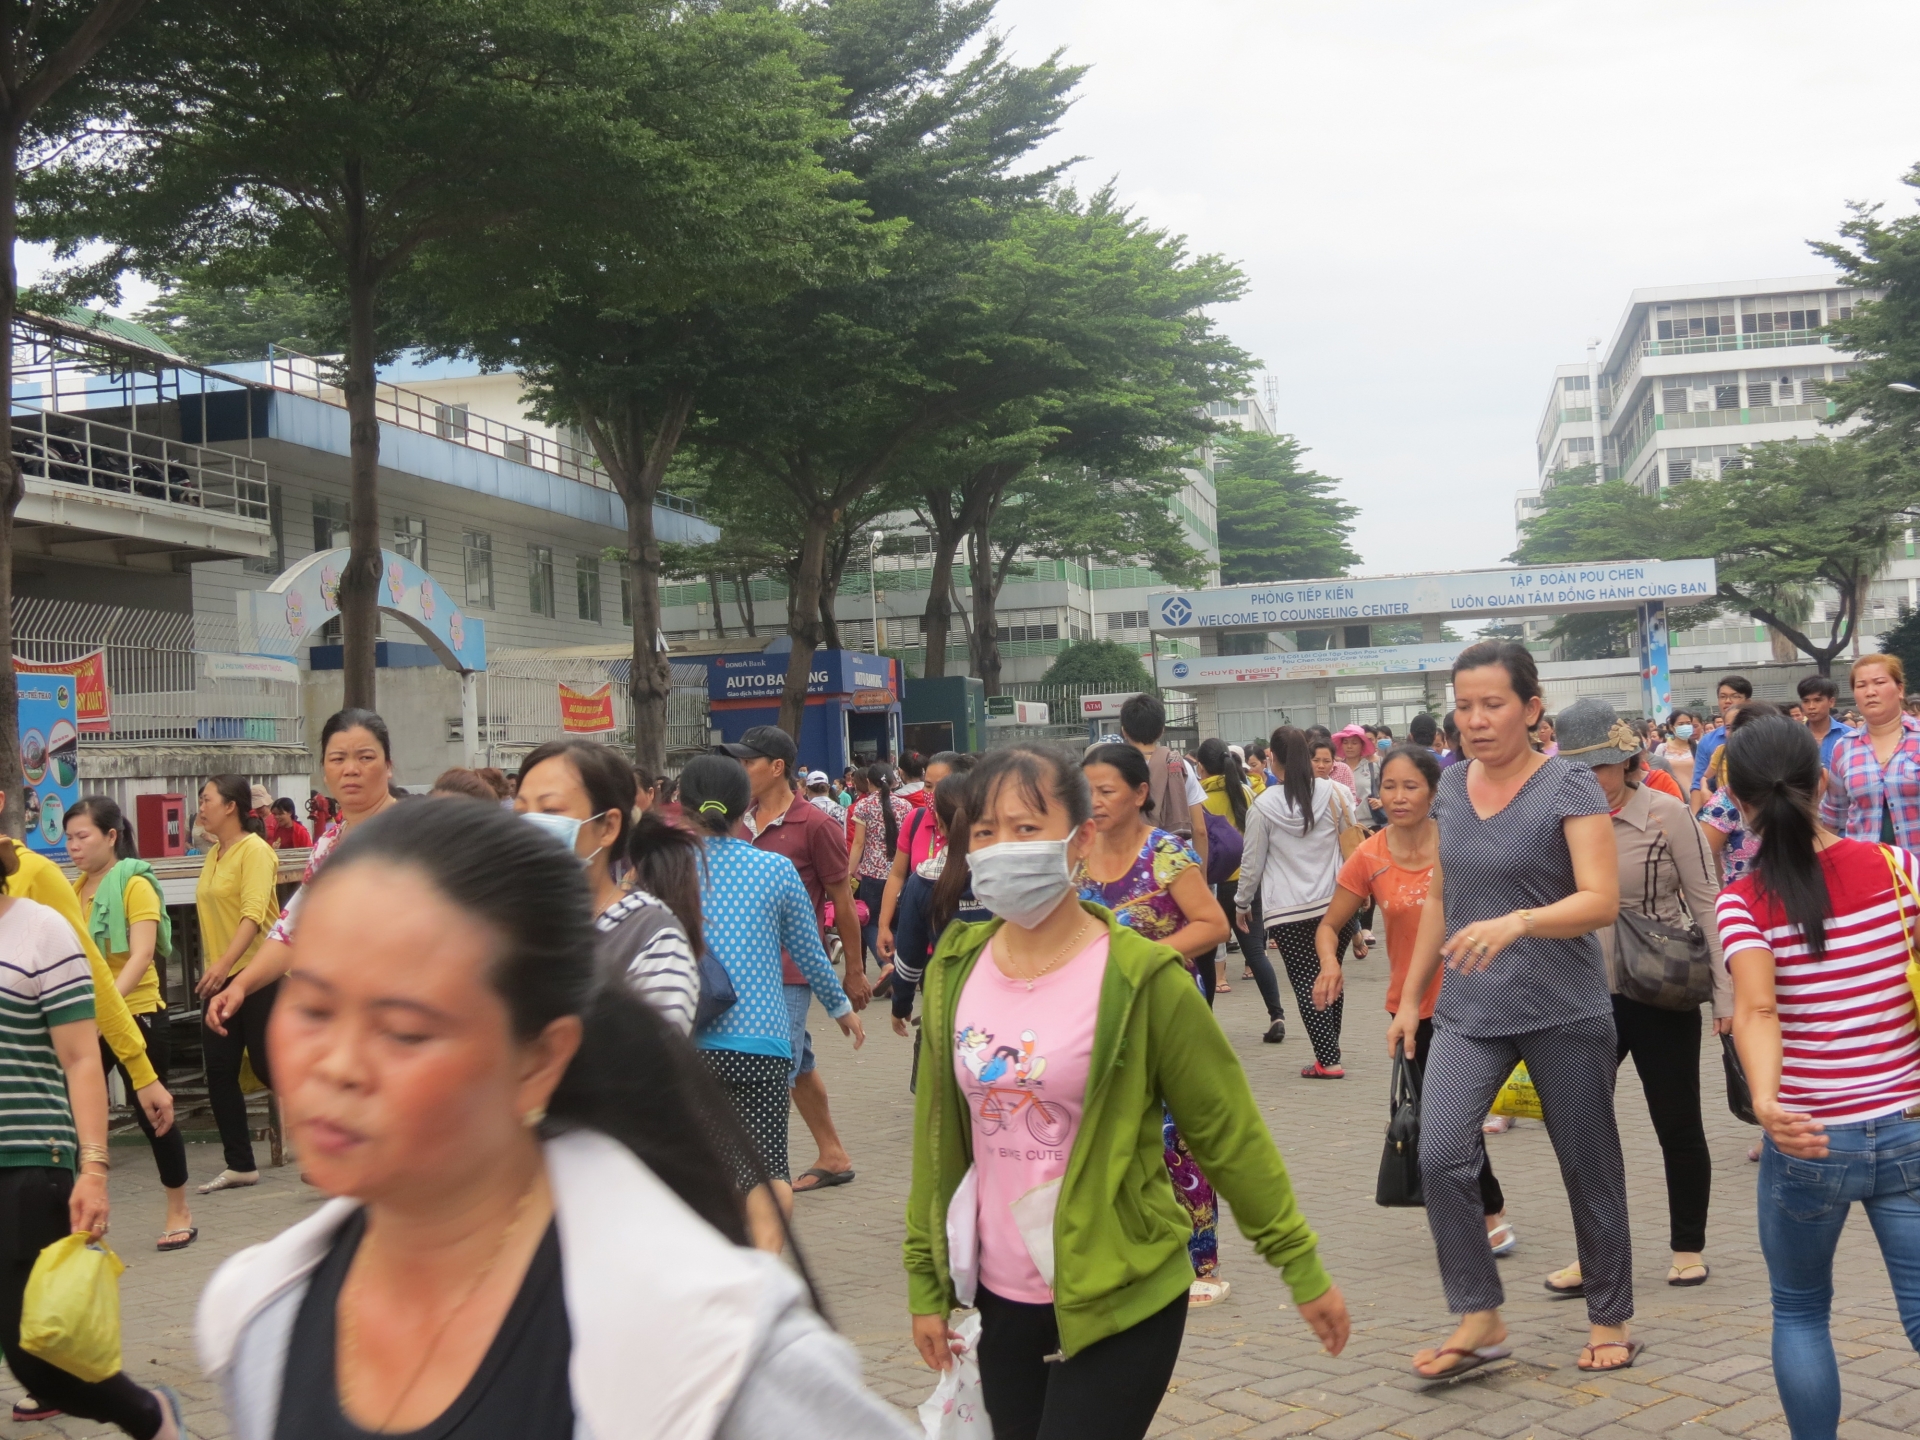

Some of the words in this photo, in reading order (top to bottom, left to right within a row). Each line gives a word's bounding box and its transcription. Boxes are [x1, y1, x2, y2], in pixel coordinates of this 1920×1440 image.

[1510, 574, 1532, 588] TẬP
[1540, 570, 1576, 586] ĐOÀN
[1580, 570, 1605, 583] POU
[1609, 568, 1644, 581] CHEN
[1251, 590, 1294, 605] PHÒNG
[1297, 586, 1322, 602] TIẾP
[1325, 584, 1354, 600] KIẾN
[1451, 595, 1484, 609] LUÔN
[1487, 593, 1525, 607] QUAN
[1528, 590, 1554, 604] TÂM
[1558, 586, 1596, 603] ĐỒNG
[1599, 586, 1635, 600] HÀNH
[1638, 583, 1677, 597] CÙNG
[1680, 582, 1707, 596] BẠN
[1198, 611, 1259, 627] WELCOME
[1262, 611, 1277, 623] TO
[1280, 605, 1359, 622] COUNSELING
[1362, 602, 1410, 617] CENTER
[748, 659, 766, 667] Bank
[726, 674, 765, 689] AUTO
[766, 671, 829, 686] BANG
[1025, 1149, 1064, 1161] CUTE
